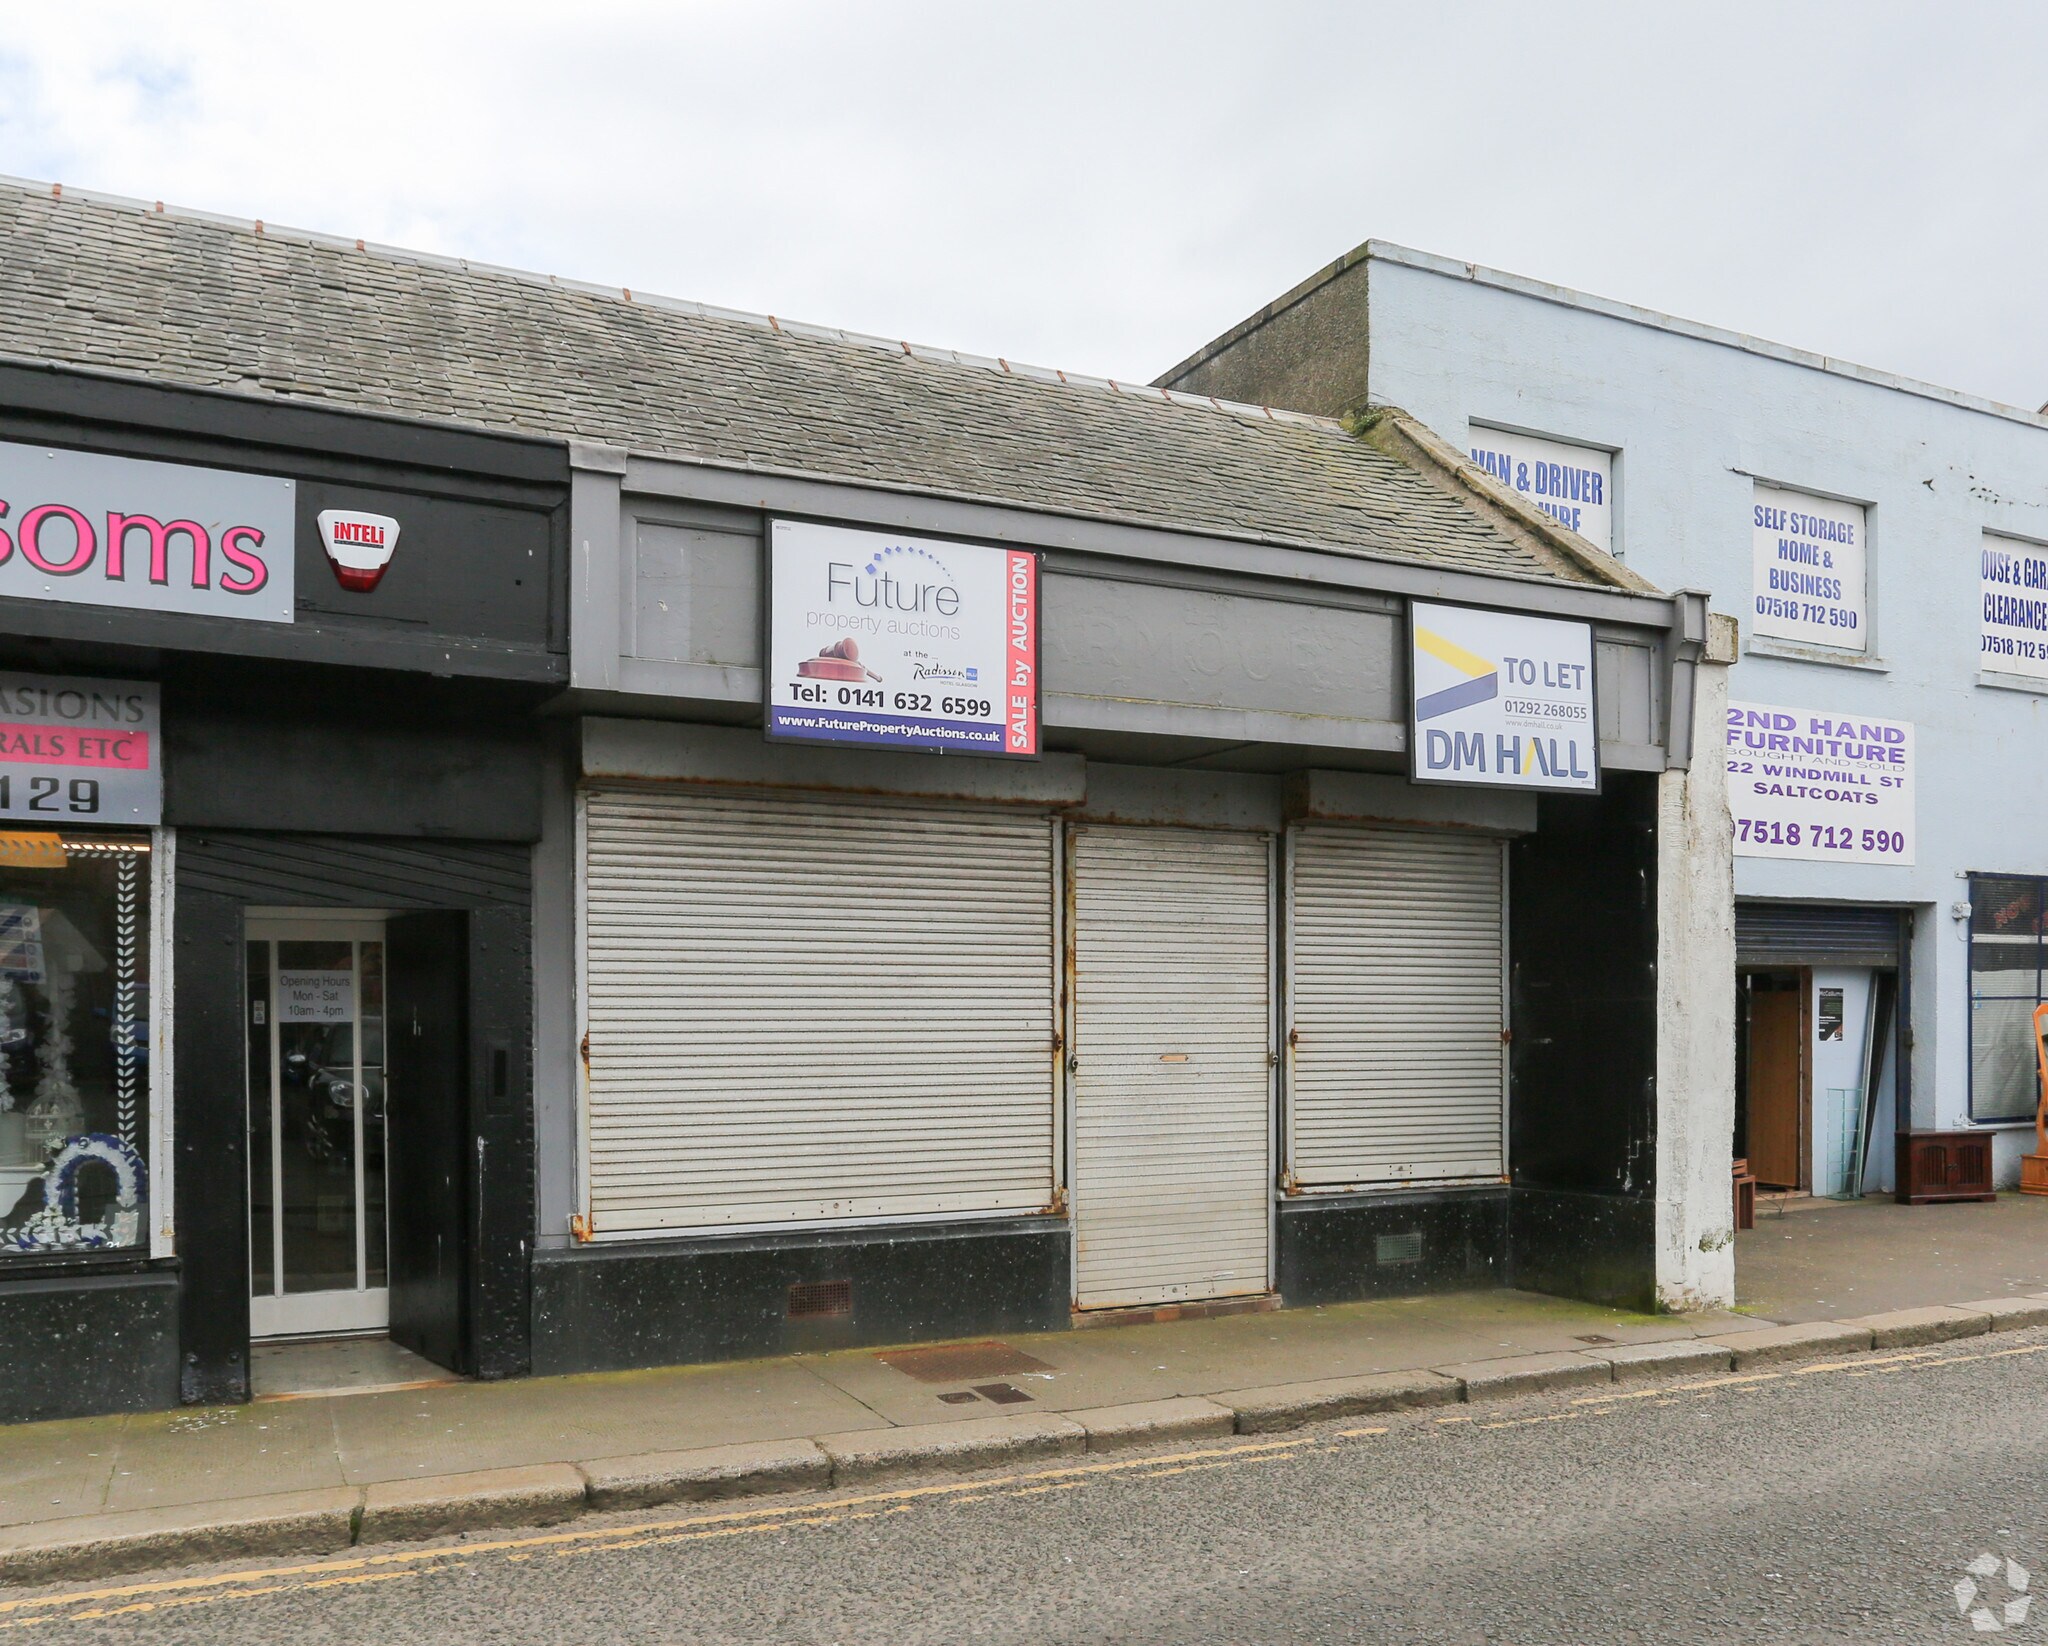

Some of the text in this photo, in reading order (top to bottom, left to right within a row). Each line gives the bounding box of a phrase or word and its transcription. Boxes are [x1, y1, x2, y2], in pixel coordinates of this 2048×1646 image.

[1516, 462, 1531, 492] &
[1535, 460, 1603, 505] DRIVER
[1538, 501, 1581, 532] RE
[1754, 504, 1855, 545] SELF STORAGE
[1778, 538, 1834, 569] HOME &
[1769, 567, 1842, 601] BUSINESS
[1981, 549, 2048, 591] OUSE & GAR
[827, 562, 960, 616] Future
[806, 610, 961, 641] property auctions
[1756, 595, 1857, 630] 07518 712 590
[1983, 592, 2048, 632] CLEARANCE
[915, 650, 929, 659] the
[1011, 557, 1032, 749] SALE by AUCTION
[2016, 640, 2036, 659] 712
[2038, 643, 2048, 660] 5
[1503, 656, 1586, 691] TO LET
[789, 683, 992, 717] Tel: 0141 632 6599
[1504, 700, 1587, 720] 01292 268055
[778, 715, 1000, 743] www.FuturePropertyAuctions.co.uk
[1504, 720, 1563, 730] www.dmhall.co.uk
[1727, 708, 1906, 744] 2ND HAND
[78, 737, 132, 761] ETC
[1426, 729, 1589, 779] DM HALL
[1727, 729, 1906, 764] FURNITURE
[1727, 748, 1905, 772] BOUGHT AND SOLD
[1727, 761, 1904, 788] 22 WINDMILL ST
[1754, 782, 1879, 805] SALTCOATS
[1810, 825, 1853, 850] 712
[1861, 830, 1905, 853] 590
[280, 975, 351, 989] Opening Hours
[293, 990, 314, 1001] Mon
[322, 990, 338, 1001] Sat
[289, 1005, 315, 1016] 10am
[323, 1005, 344, 1018] 4pm
